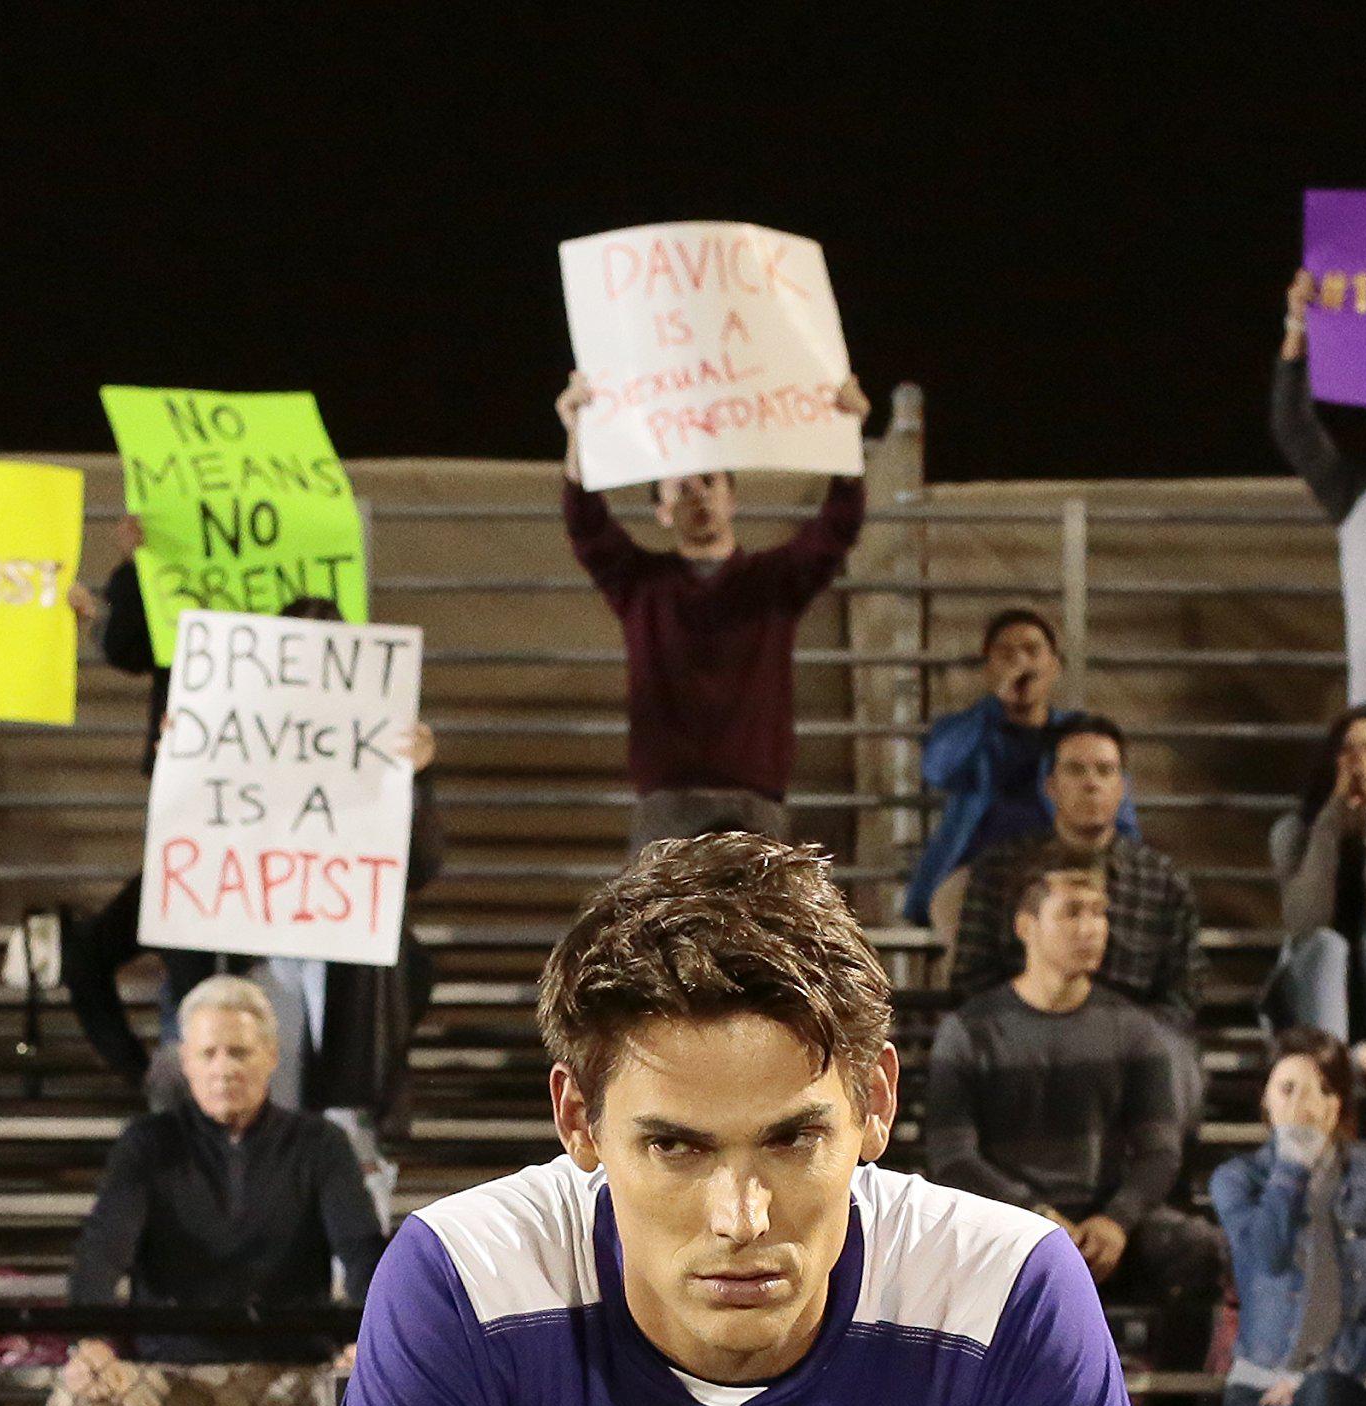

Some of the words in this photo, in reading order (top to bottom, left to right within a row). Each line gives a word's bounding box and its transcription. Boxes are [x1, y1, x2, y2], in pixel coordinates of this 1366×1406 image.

[601, 234, 812, 300] DAVICK
[653, 306, 692, 347] IS
[720, 309, 752, 348] A
[164, 393, 247, 445] NO
[131, 451, 343, 502] MEANS
[198, 495, 280, 557] NO
[182, 620, 412, 698] BRENT
[166, 706, 403, 773] DAVICK
[204, 776, 268, 827] IS
[290, 785, 337, 837] A
[160, 836, 402, 937] RAPIST
